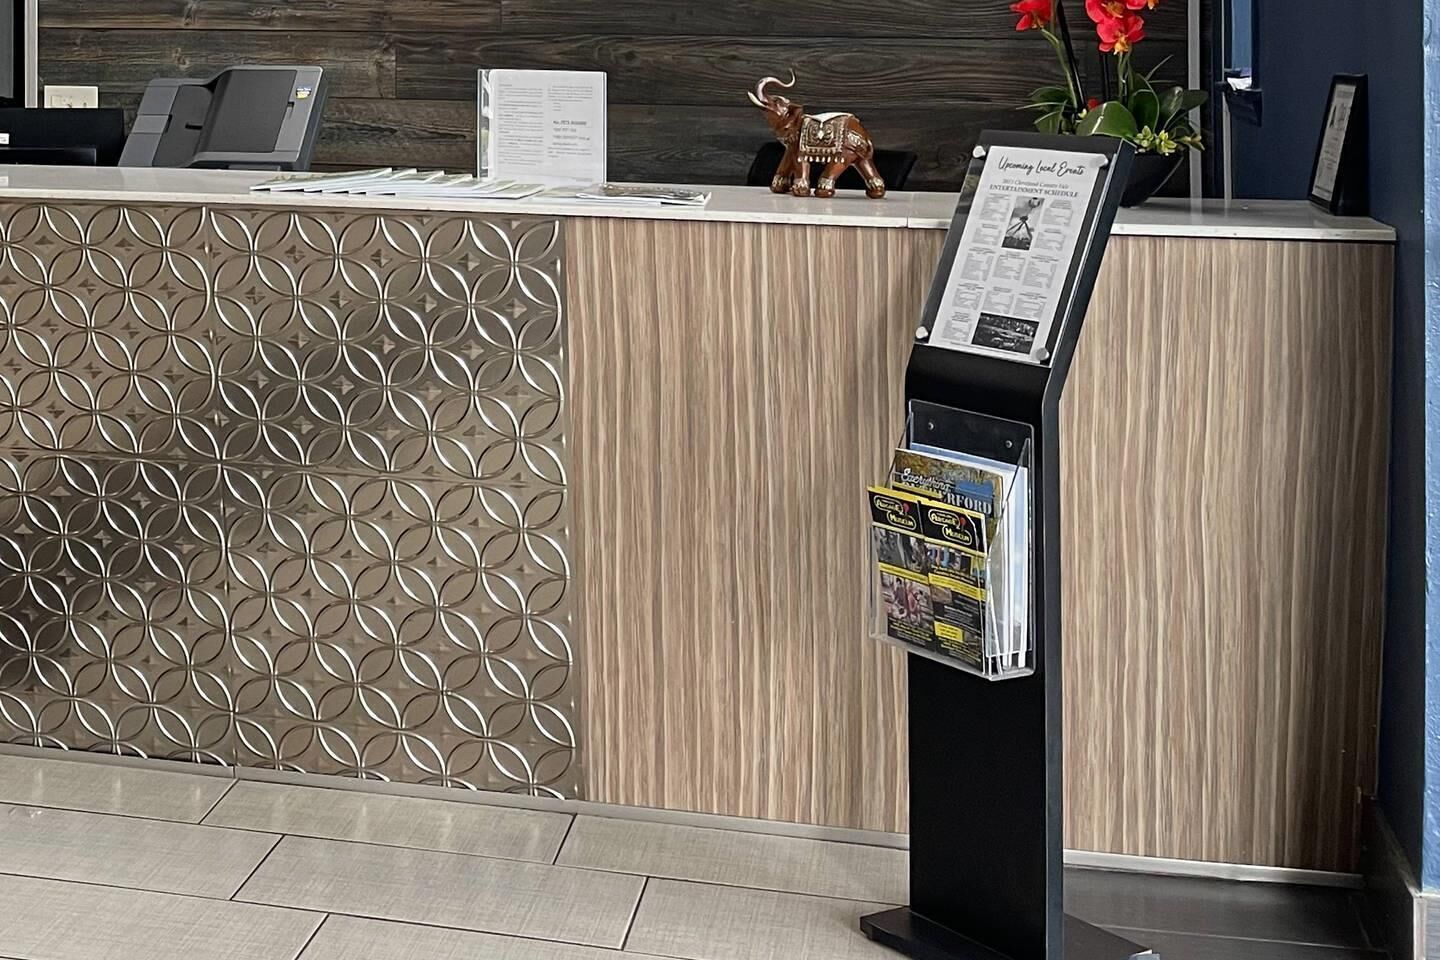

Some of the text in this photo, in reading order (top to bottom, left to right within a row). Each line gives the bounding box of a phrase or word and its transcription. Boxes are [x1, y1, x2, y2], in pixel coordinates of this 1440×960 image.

[998, 155, 1086, 178] Upcoming Local Events
[989, 183, 1079, 198] ENTERTAINMENT SCHEDULE
